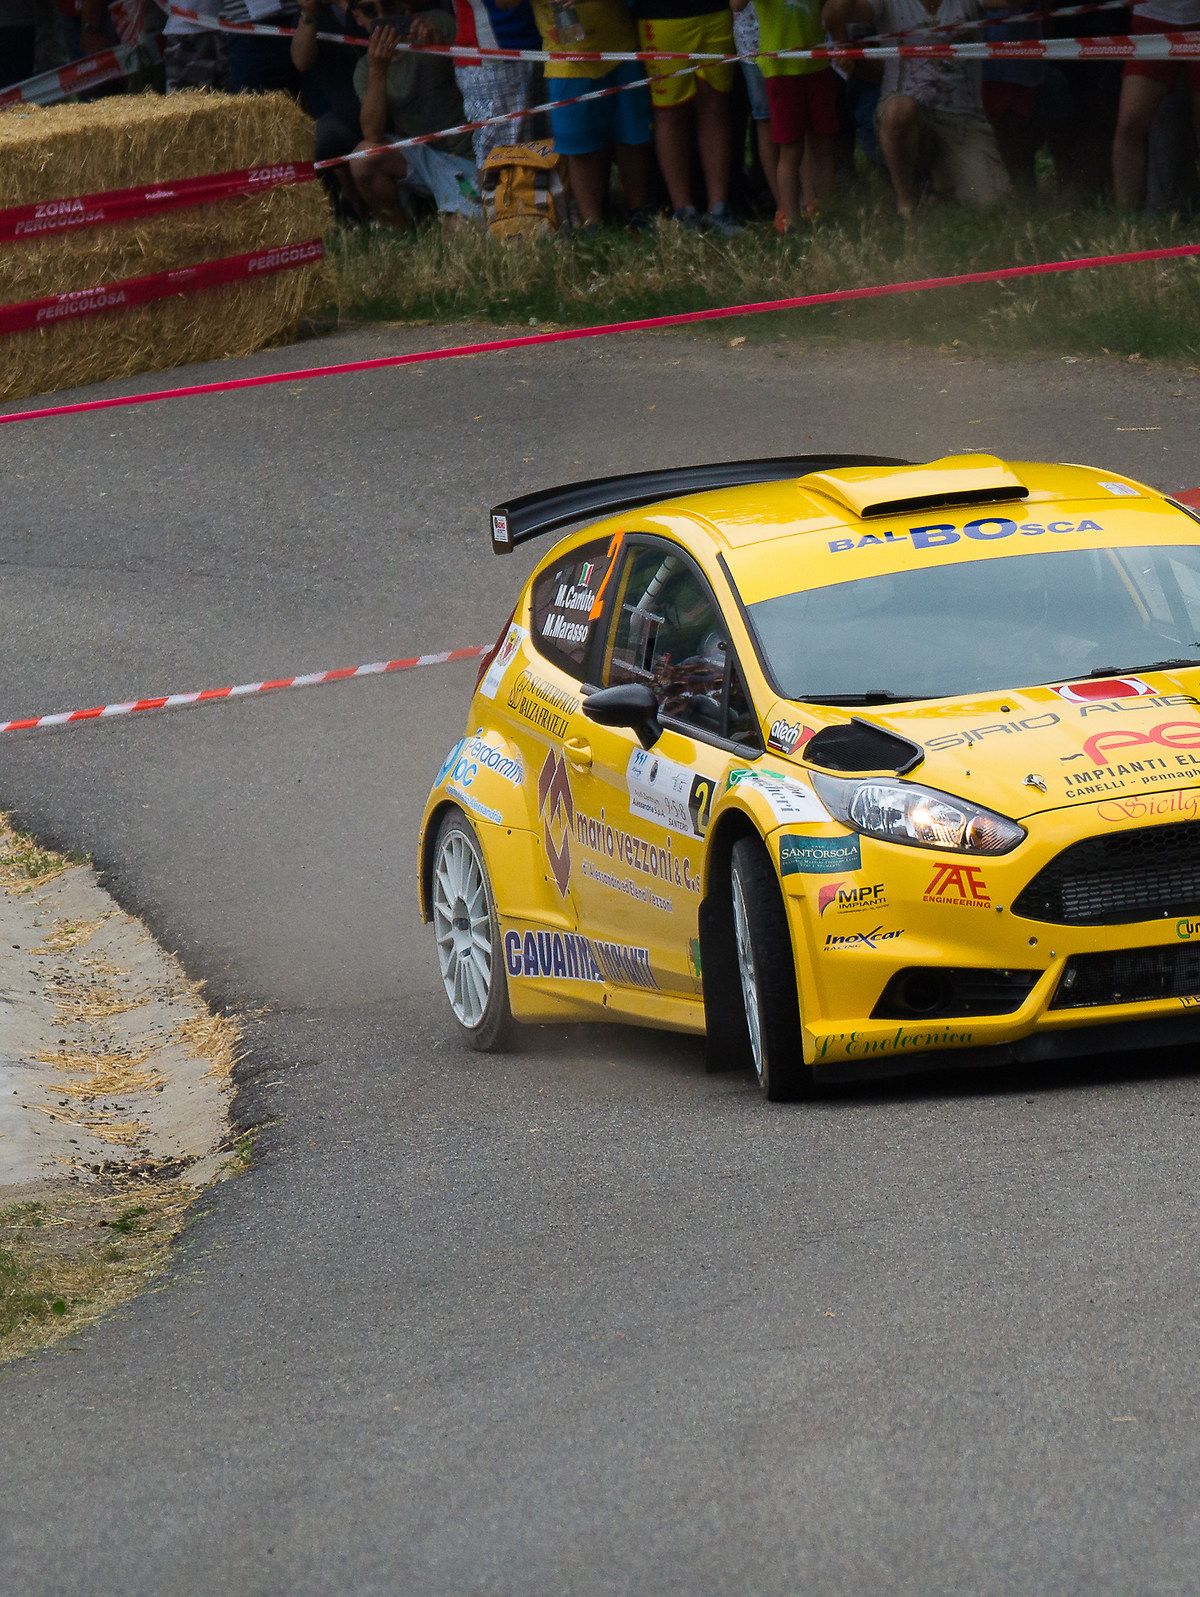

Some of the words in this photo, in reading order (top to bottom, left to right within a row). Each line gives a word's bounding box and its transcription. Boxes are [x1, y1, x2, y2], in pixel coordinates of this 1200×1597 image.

[247, 165, 296, 182] ZONA
[14, 207, 105, 235] PERICOLOSA
[34, 199, 84, 218] ZONA
[35, 291, 127, 321] PERICOLOSA
[829, 517, 1104, 553] BALBOSCA
[542, 613, 589, 643] M.Marasso
[923, 713, 1061, 752] SIRIO
[1064, 758, 1172, 787] IMPIANTI
[1065, 780, 1125, 798] CANELLI
[695, 782, 709, 835] 2
[576, 807, 614, 858] mario
[615, 834, 673, 884] vezzoni
[674, 856, 683, 888] &
[839, 883, 885, 903] MPF
[923, 863, 991, 902] TAE
[839, 897, 887, 910] IMPIANTI
[922, 895, 992, 909] ENGINEERING
[504, 930, 606, 983] CAVANNA
